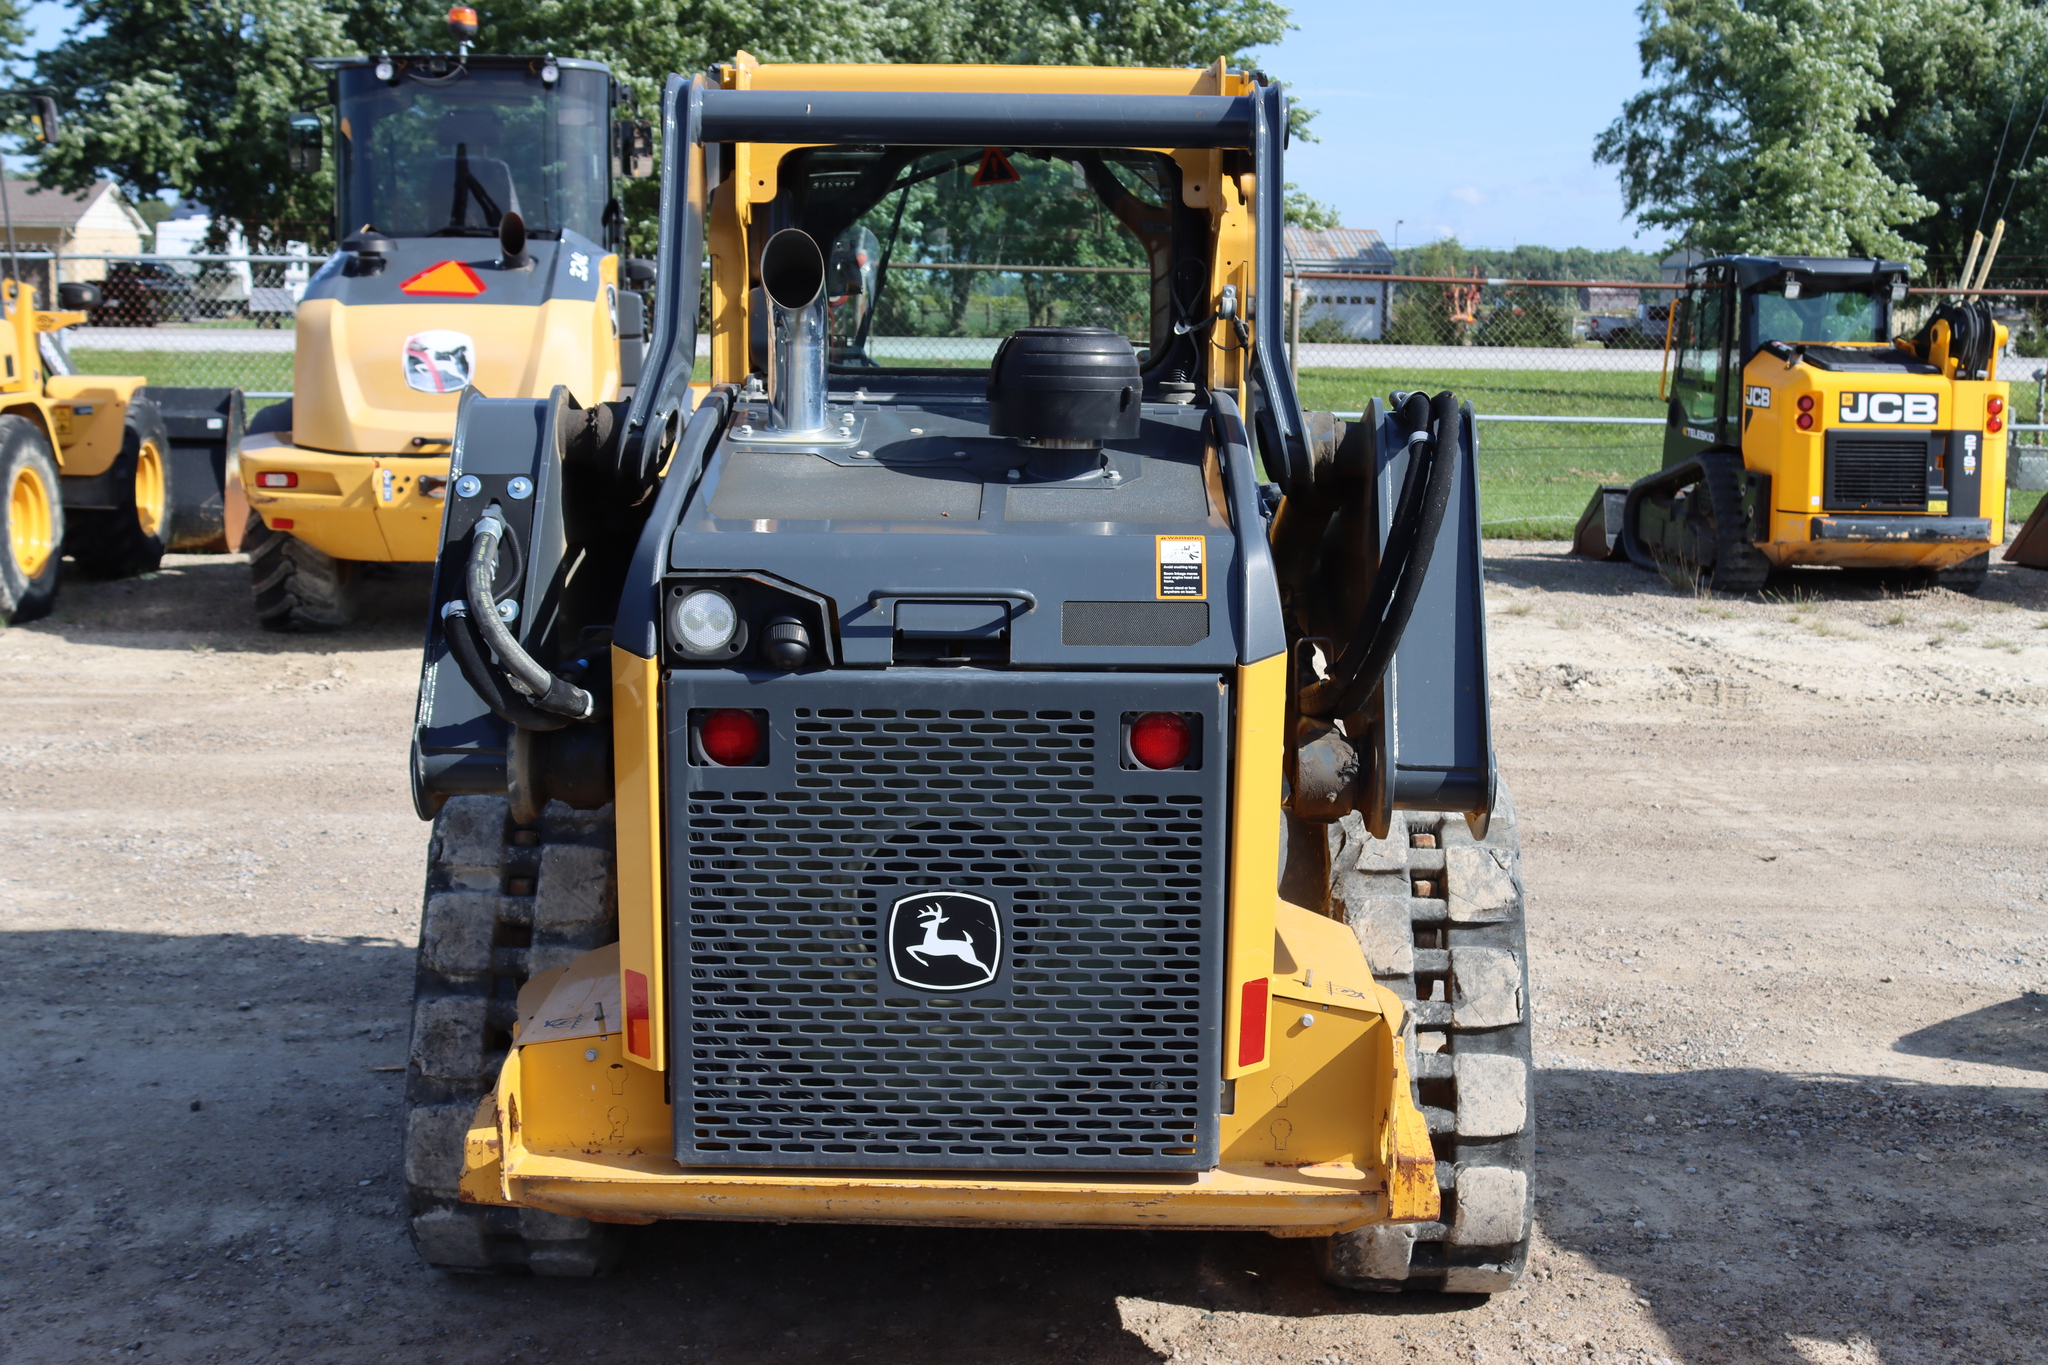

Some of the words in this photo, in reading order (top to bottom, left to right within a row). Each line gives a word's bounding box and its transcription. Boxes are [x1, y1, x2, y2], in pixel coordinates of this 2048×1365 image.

[1745, 386, 1770, 408] JCB
[1840, 393, 1937, 423] JCB
[533, 667, 547, 680] USA
